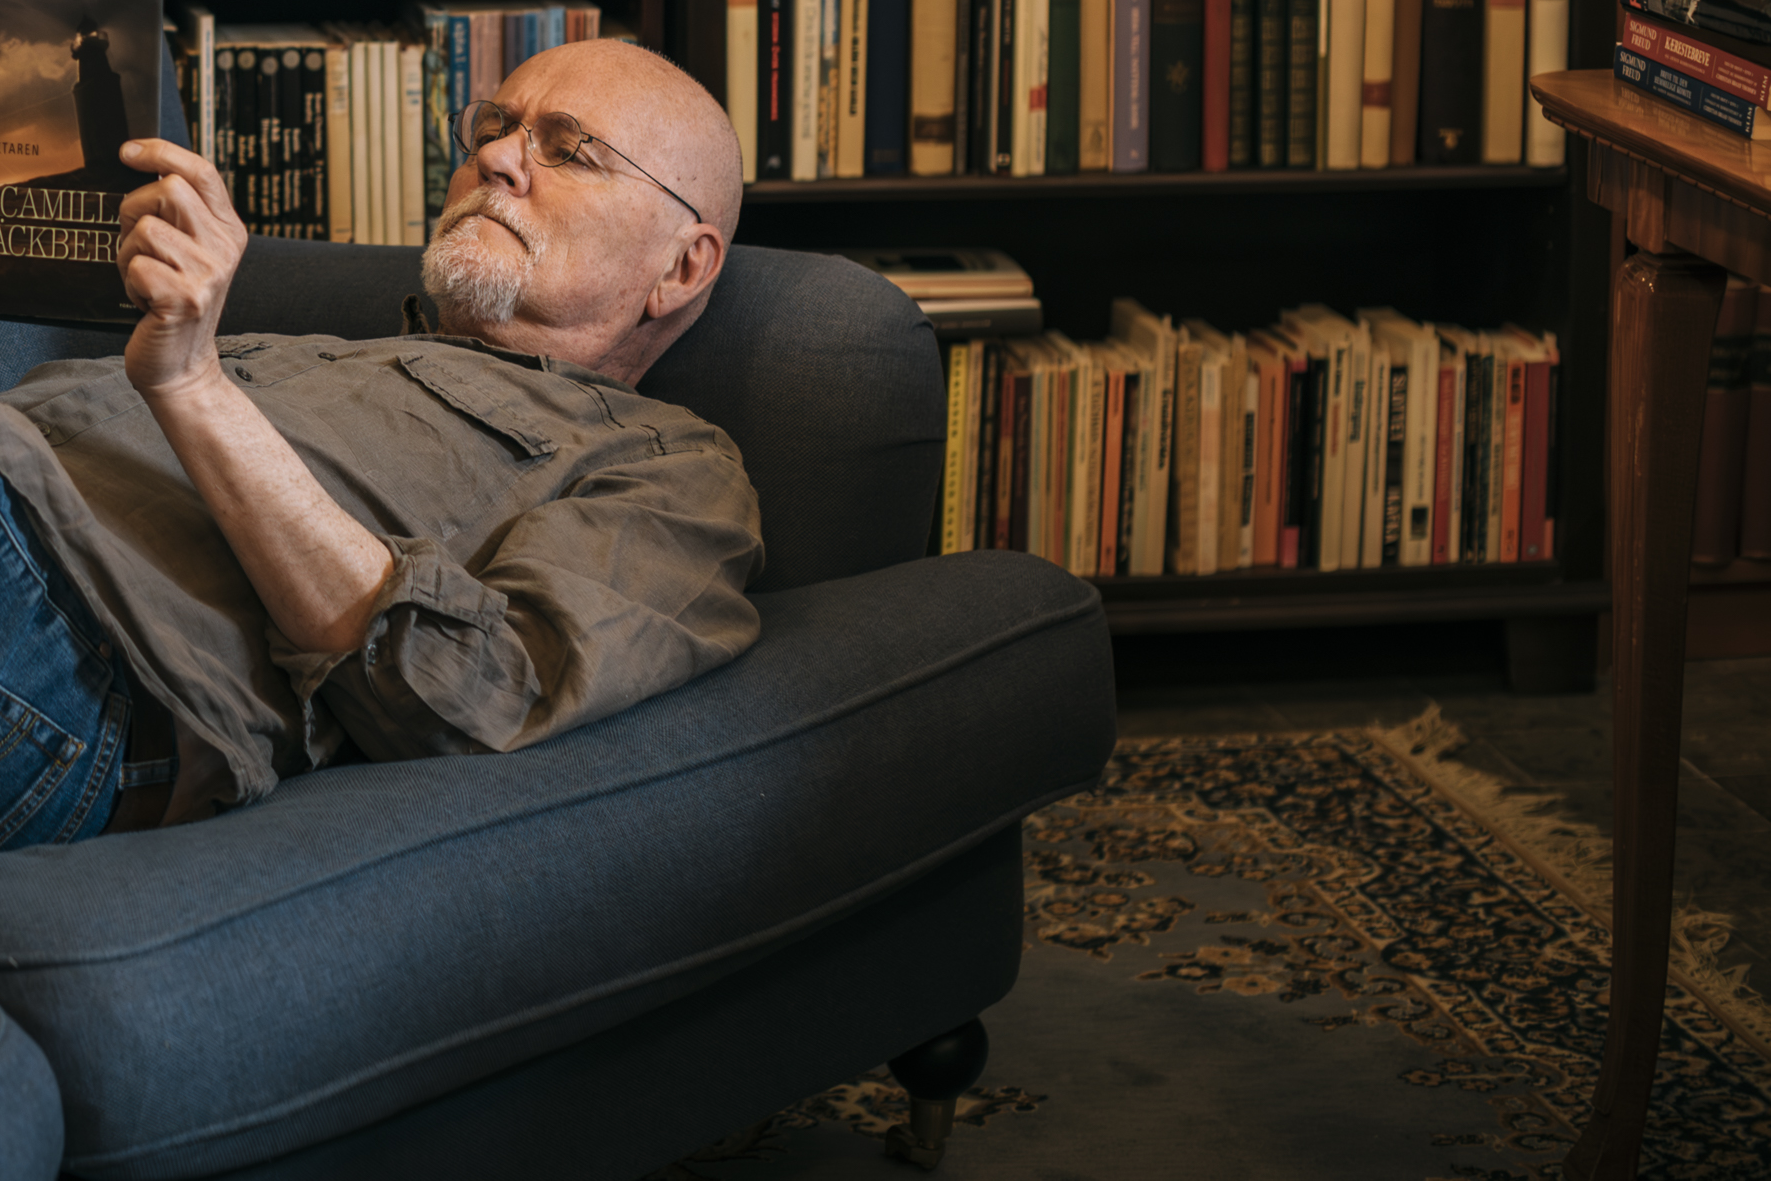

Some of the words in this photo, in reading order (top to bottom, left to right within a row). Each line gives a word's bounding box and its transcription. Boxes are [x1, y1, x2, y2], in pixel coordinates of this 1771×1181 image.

[1629, 20, 1658, 40] SIGMUND
[1631, 34, 1651, 51] FREUD
[1664, 36, 1711, 67] KÆRESTEBREVE
[1619, 51, 1647, 71] SIGMUND
[1622, 64, 1641, 82] FREUD
